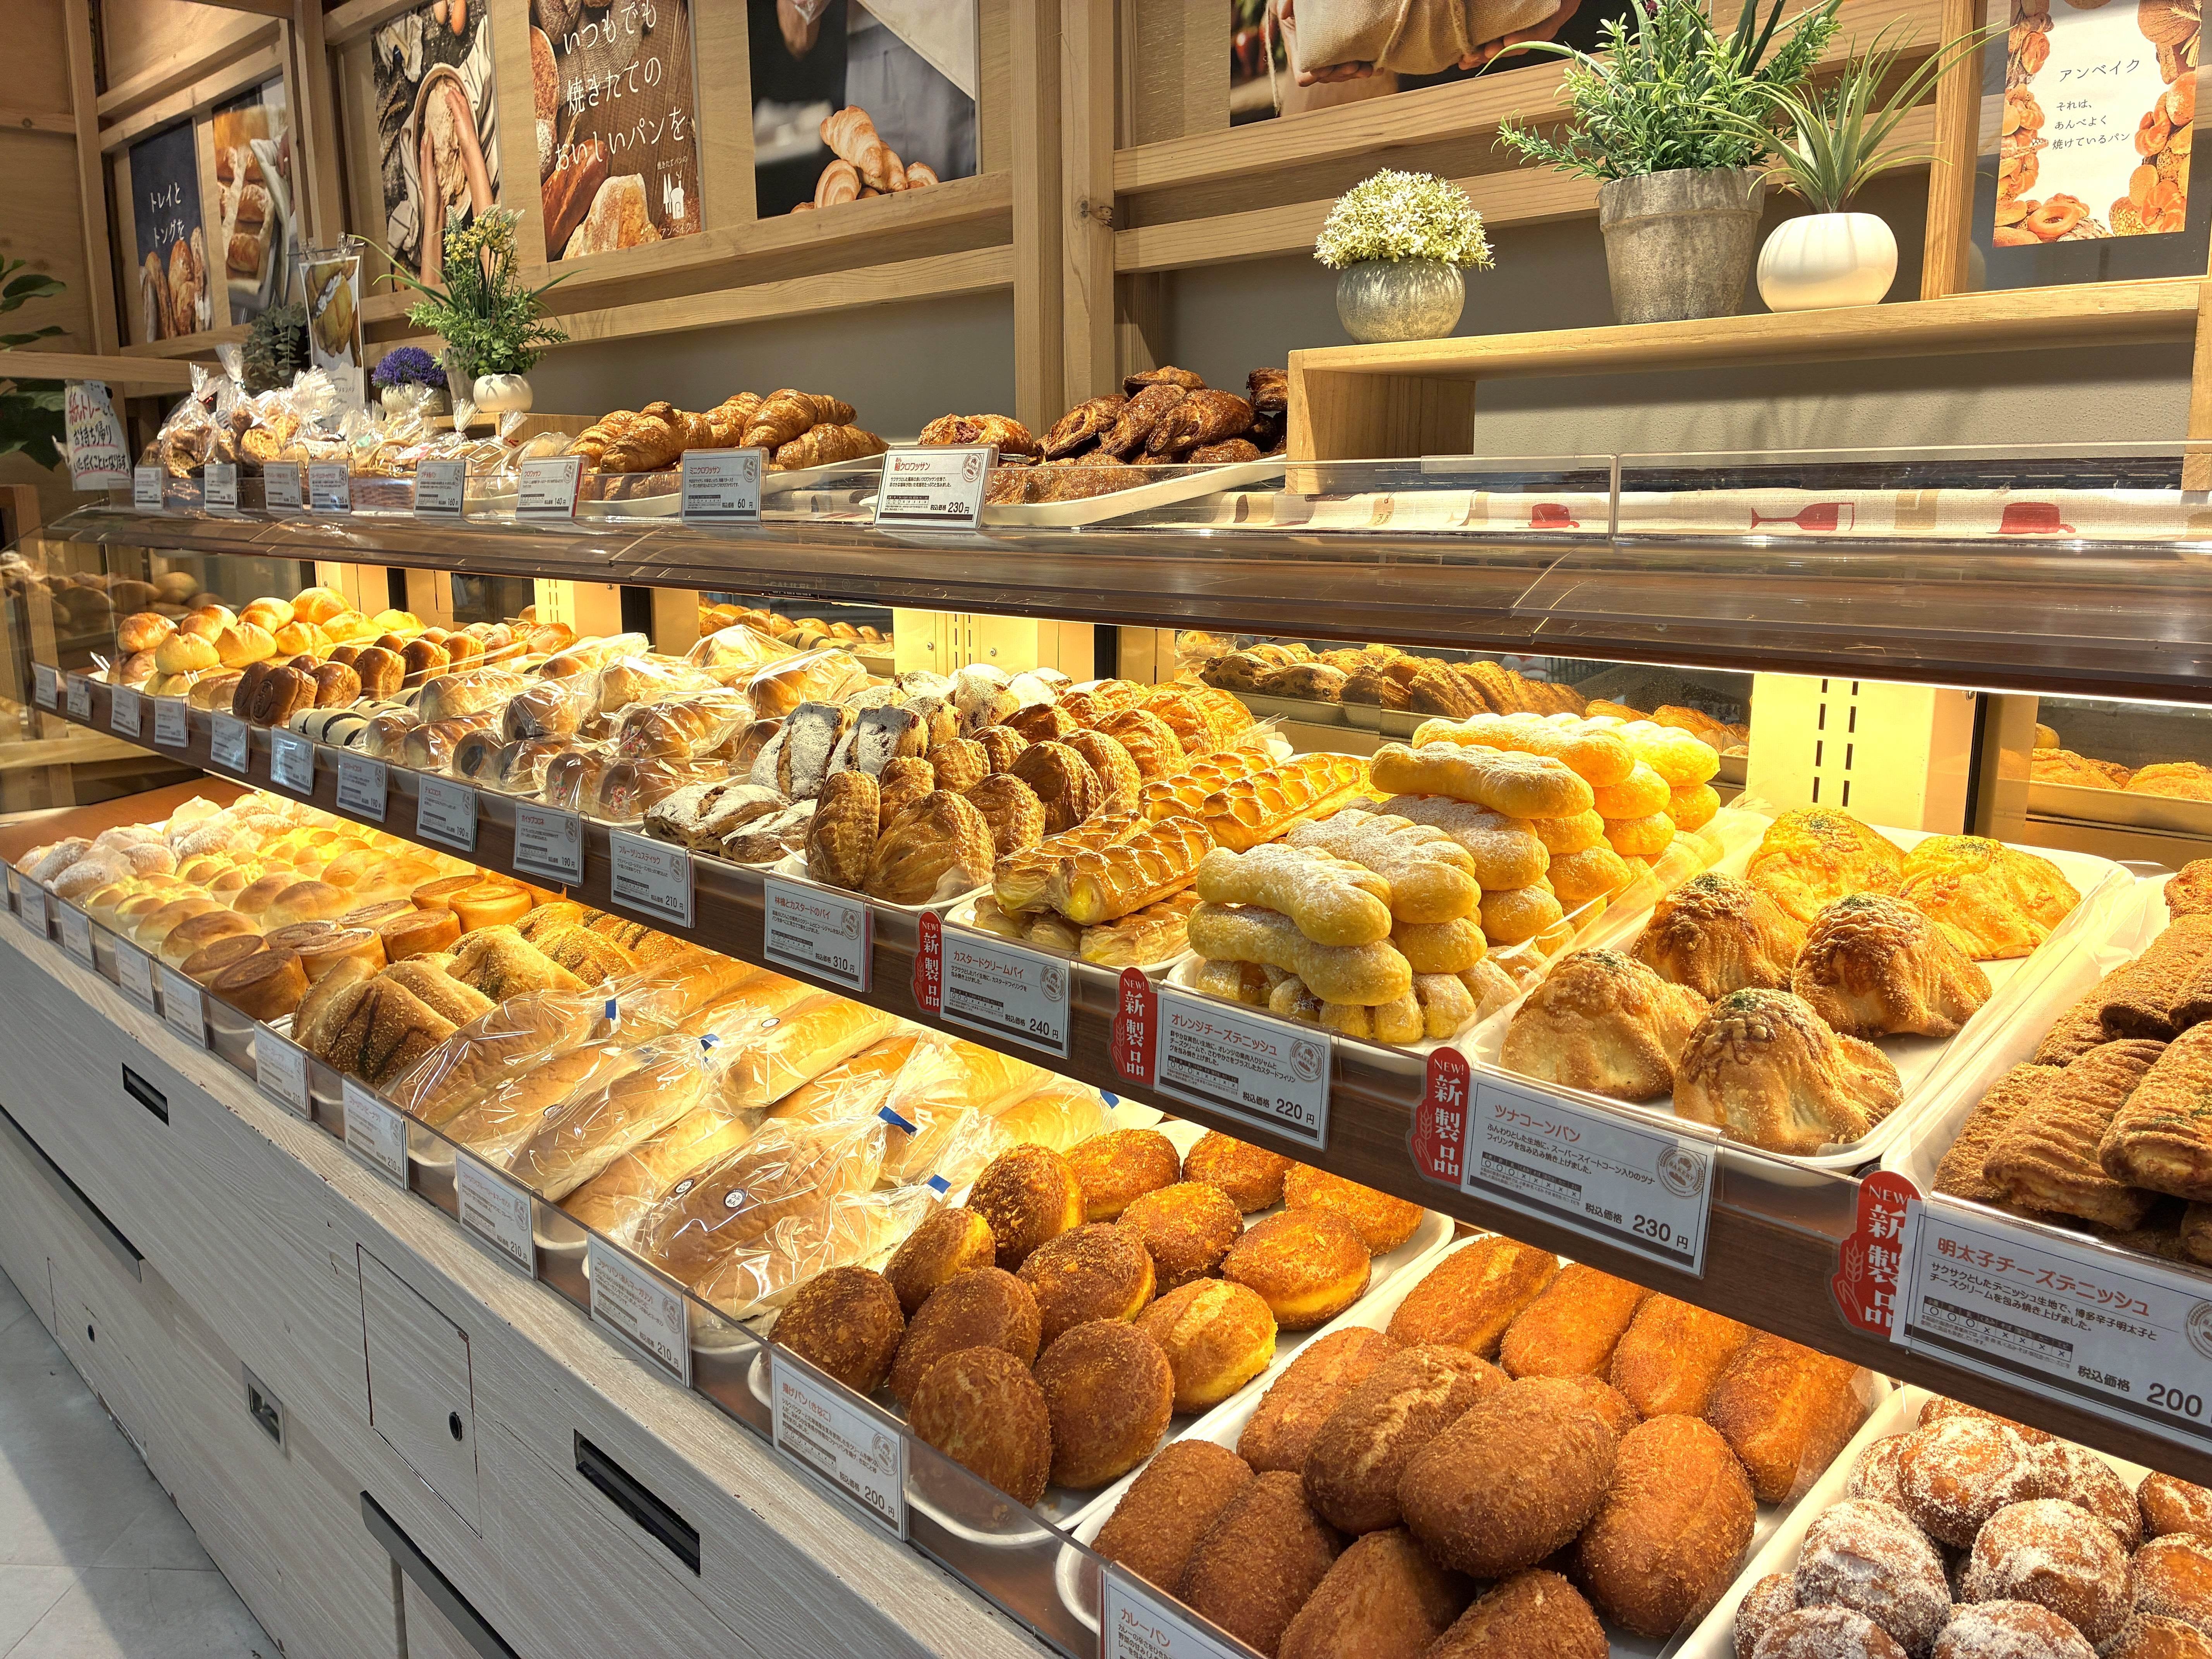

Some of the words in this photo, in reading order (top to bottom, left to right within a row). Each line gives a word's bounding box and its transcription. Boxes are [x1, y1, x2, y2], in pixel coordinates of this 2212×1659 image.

[564, 0, 657, 55] いつもでも
[2059, 59, 2140, 82] アンベイク
[567, 57, 661, 117] 焼きたての
[2056, 100, 2092, 111] それは、
[2054, 115, 2107, 130] あんべよく
[555, 106, 685, 172] おいしいパンを
[2052, 133, 2130, 150] 焼けているパン
[150, 182, 181, 213] トレイと
[153, 218, 185, 247] トングを
[689, 466, 721, 474] ミニクロワッサン
[894, 462, 931, 471] 餡クロワッサン
[737, 498, 745, 508] 60
[947, 501, 964, 513] 230
[457, 826, 465, 837] 190
[562, 856, 570, 867] 190
[665, 895, 677, 908] 210
[922, 922, 938, 931] NEW!
[833, 955, 847, 971] 310
[849, 964, 855, 973] 円
[923, 933, 939, 1007] 新製品
[954, 950, 1024, 979] カスタードクリームパイ
[1124, 977, 1145, 990] NEW!
[1005, 1013, 1025, 1027] 税込価格
[1029, 1017, 1049, 1037] 240
[1052, 1029, 1058, 1039] 円
[1125, 991, 1145, 1077] 新製品
[1171, 1012, 1278, 1057] オレンジチーズデニッシュ
[1434, 1059, 1464, 1076] NEW!
[1243, 1091, 1269, 1108] 税込価格
[1276, 1097, 1302, 1121] 220
[1306, 1113, 1314, 1125] 円
[1434, 1075, 1463, 1178] 新製品
[1494, 1103, 1581, 1145] ツナコーンパン
[387, 1155, 396, 1171] 210
[1486, 1132, 1592, 1175] フィリングを包み込み焼き上げました。
[1487, 1123, 1656, 1187] ふんわりとした生地に、スーパースイートコーン入りのツナ
[1667, 1159, 1696, 1182] BAKERY
[1585, 1202, 1623, 1225] 税込価格
[1632, 1212, 1672, 1244] 230
[1676, 1234, 1689, 1250] 円
[510, 1240, 522, 1258] 210
[1937, 1236, 2150, 1318] 明太子チーズデニッシュ
[1929, 1271, 2093, 1334] チーズクリームを包み焼き上げました。
[1930, 1261, 2157, 1343] サクサクとしたデニッシュ生地で、博多辛子明太子と
[657, 1340, 672, 1363] 210
[2077, 1364, 2131, 1394] 税込価格
[2147, 1379, 2203, 1421] 200
[864, 1484, 884, 1511] 200
[888, 1505, 895, 1519] 円
[1121, 1608, 1170, 1647] カレーパン
